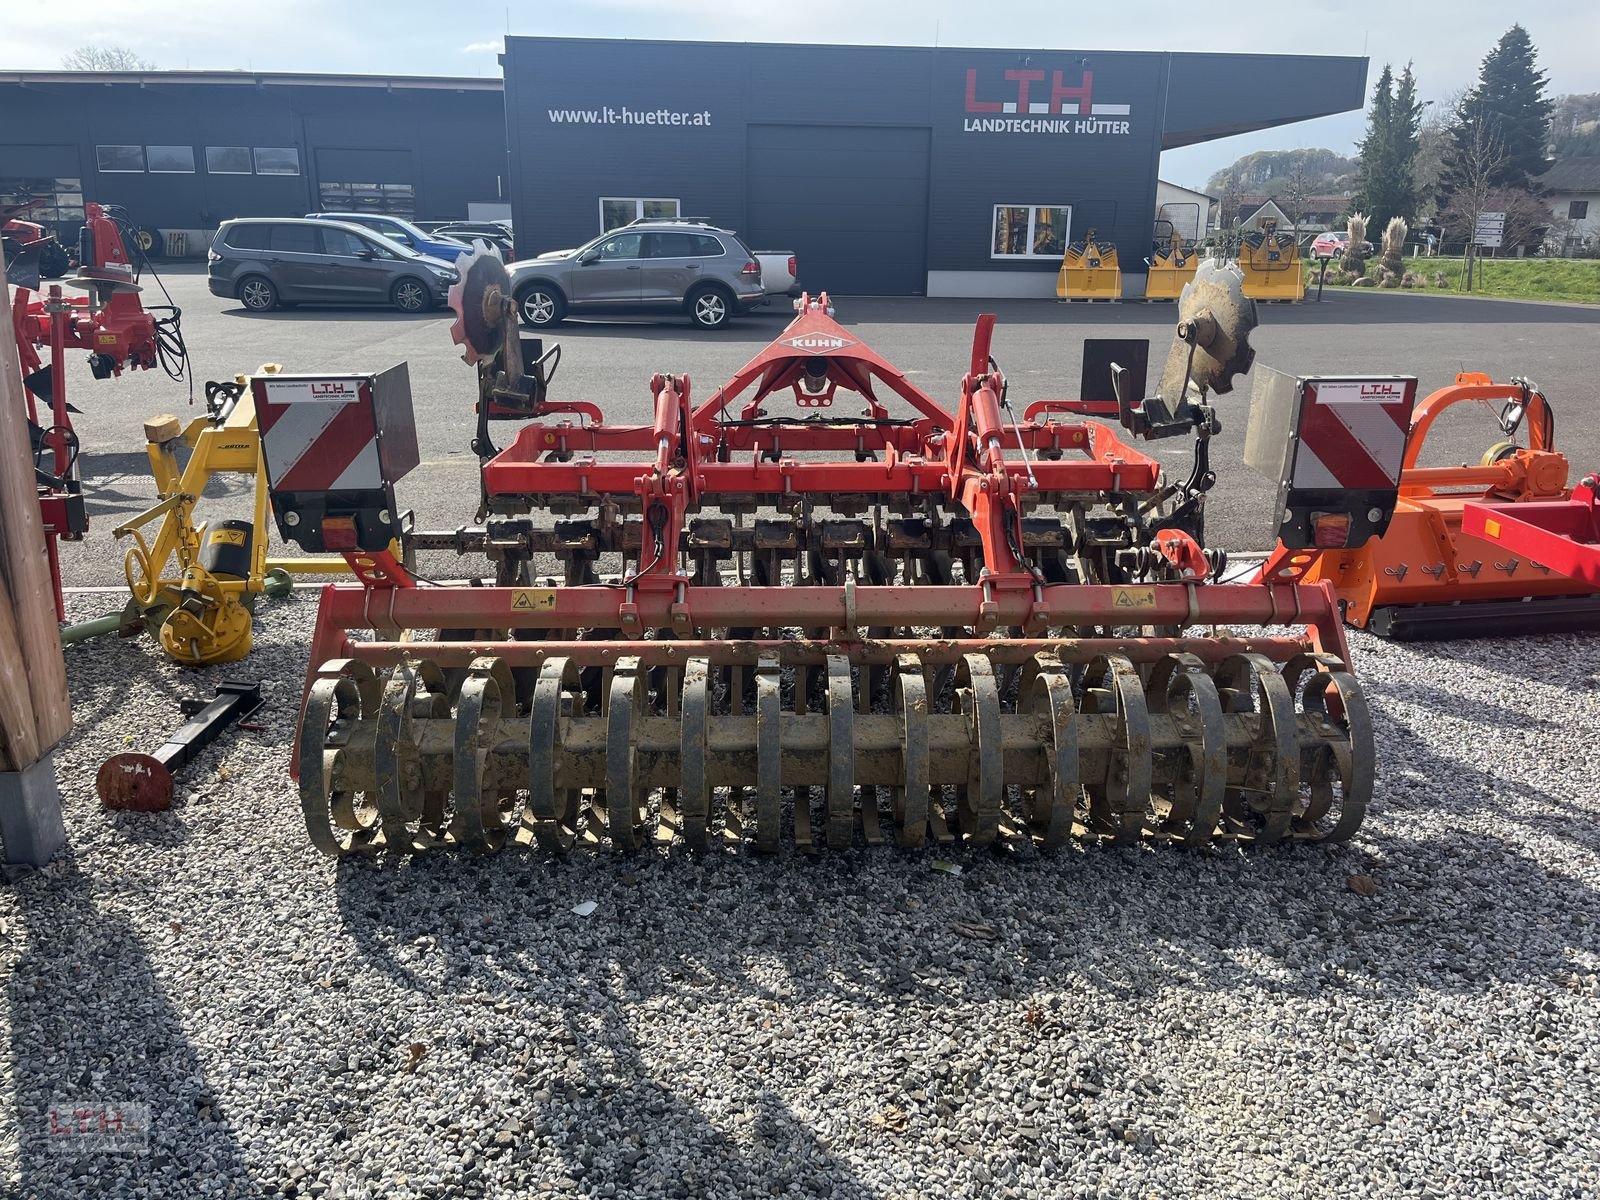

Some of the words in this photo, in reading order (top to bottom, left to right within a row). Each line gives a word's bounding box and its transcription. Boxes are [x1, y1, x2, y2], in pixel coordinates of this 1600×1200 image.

[548, 106, 711, 126] www.lt-huetter.at
[964, 119, 1070, 133] LANDTECHNIK
[1074, 117, 1130, 134] HÜTTER
[792, 339, 843, 347] KUHN
